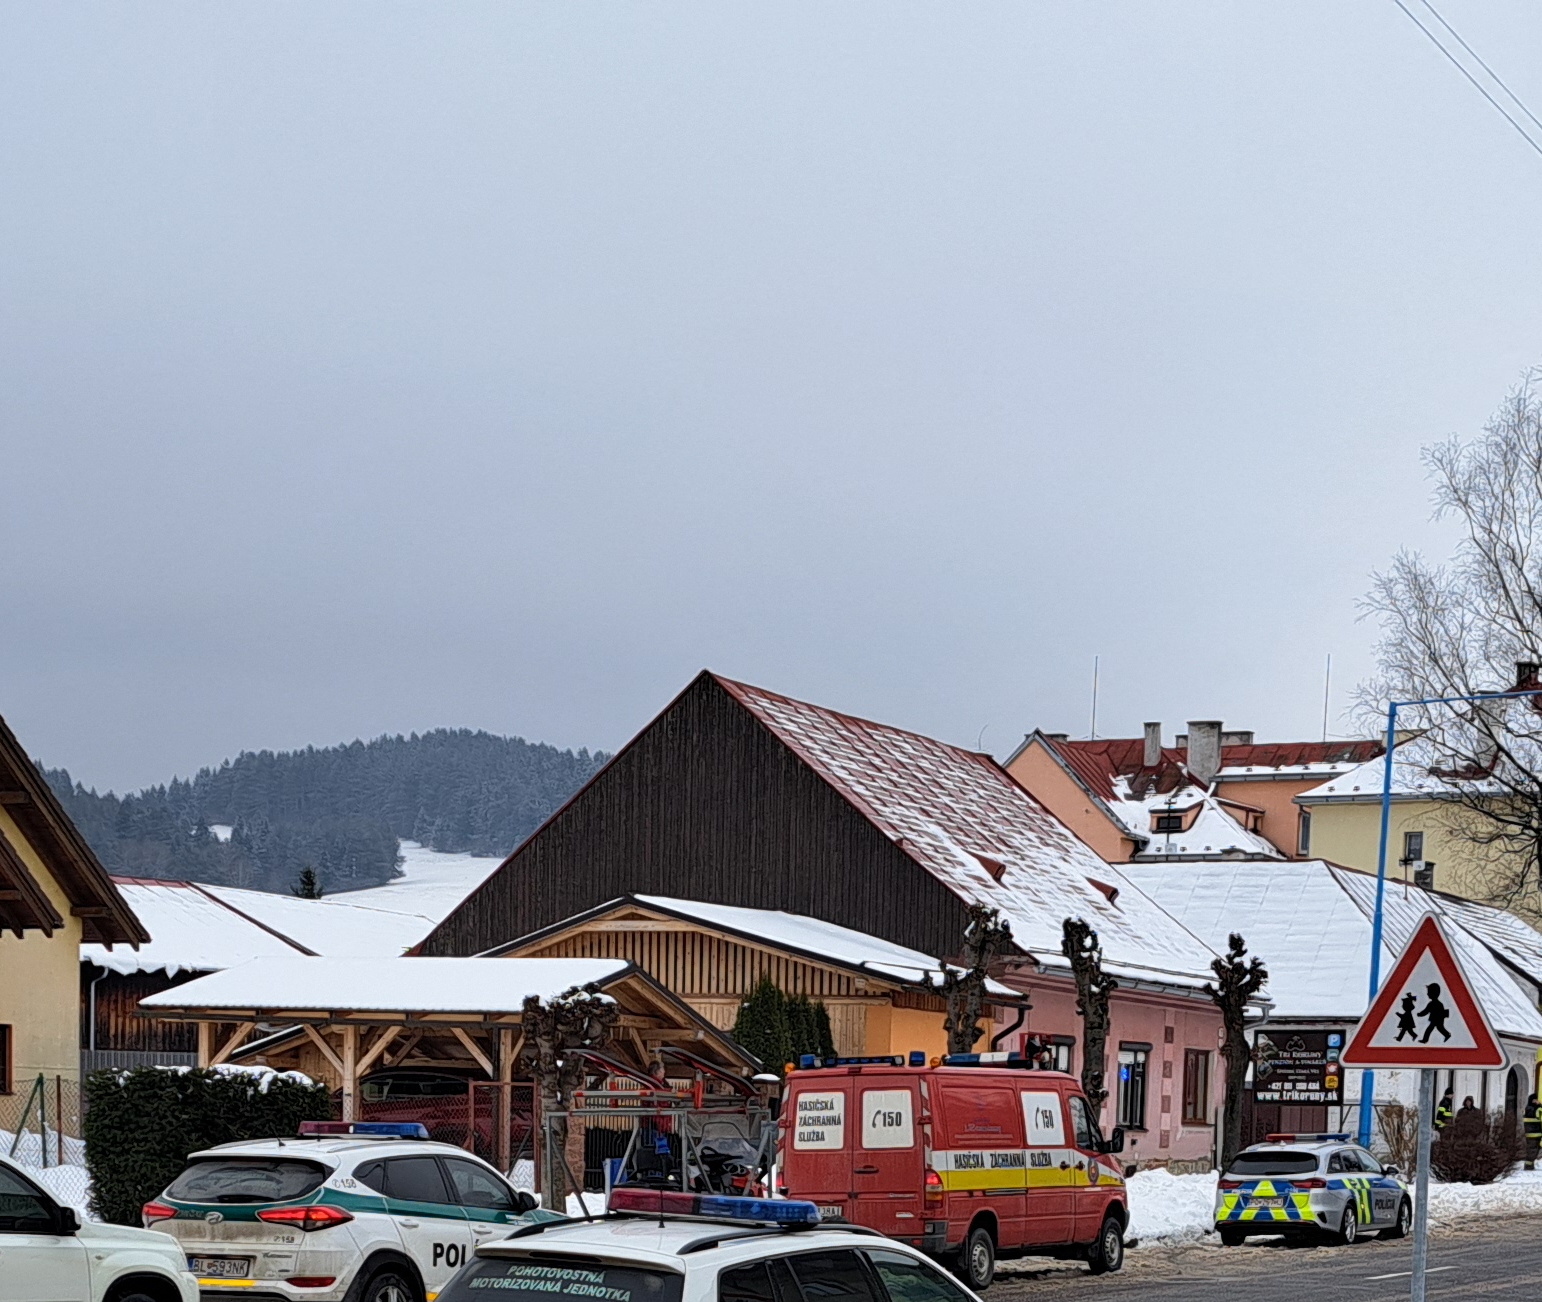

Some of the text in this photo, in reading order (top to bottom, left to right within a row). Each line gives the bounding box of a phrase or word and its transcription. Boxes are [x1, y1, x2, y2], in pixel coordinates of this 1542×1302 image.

[799, 1098, 834, 1112] HASIČSKÁ
[799, 1113, 842, 1127] ZÁCHRANNÁ
[882, 1111, 902, 1128] 150
[1041, 1109, 1054, 1129] 150
[798, 1130, 826, 1142] SLUŽBA
[954, 1151, 1052, 1169] HASIČSKÁ ZÁCHRANNÁ SLUŽBA
[341, 1178, 357, 1189] 158
[507, 1265, 606, 1284] POHOTOVOSTNÁ
[469, 1278, 632, 1302] MOTORIZOVANÁ JEDNOTKA
